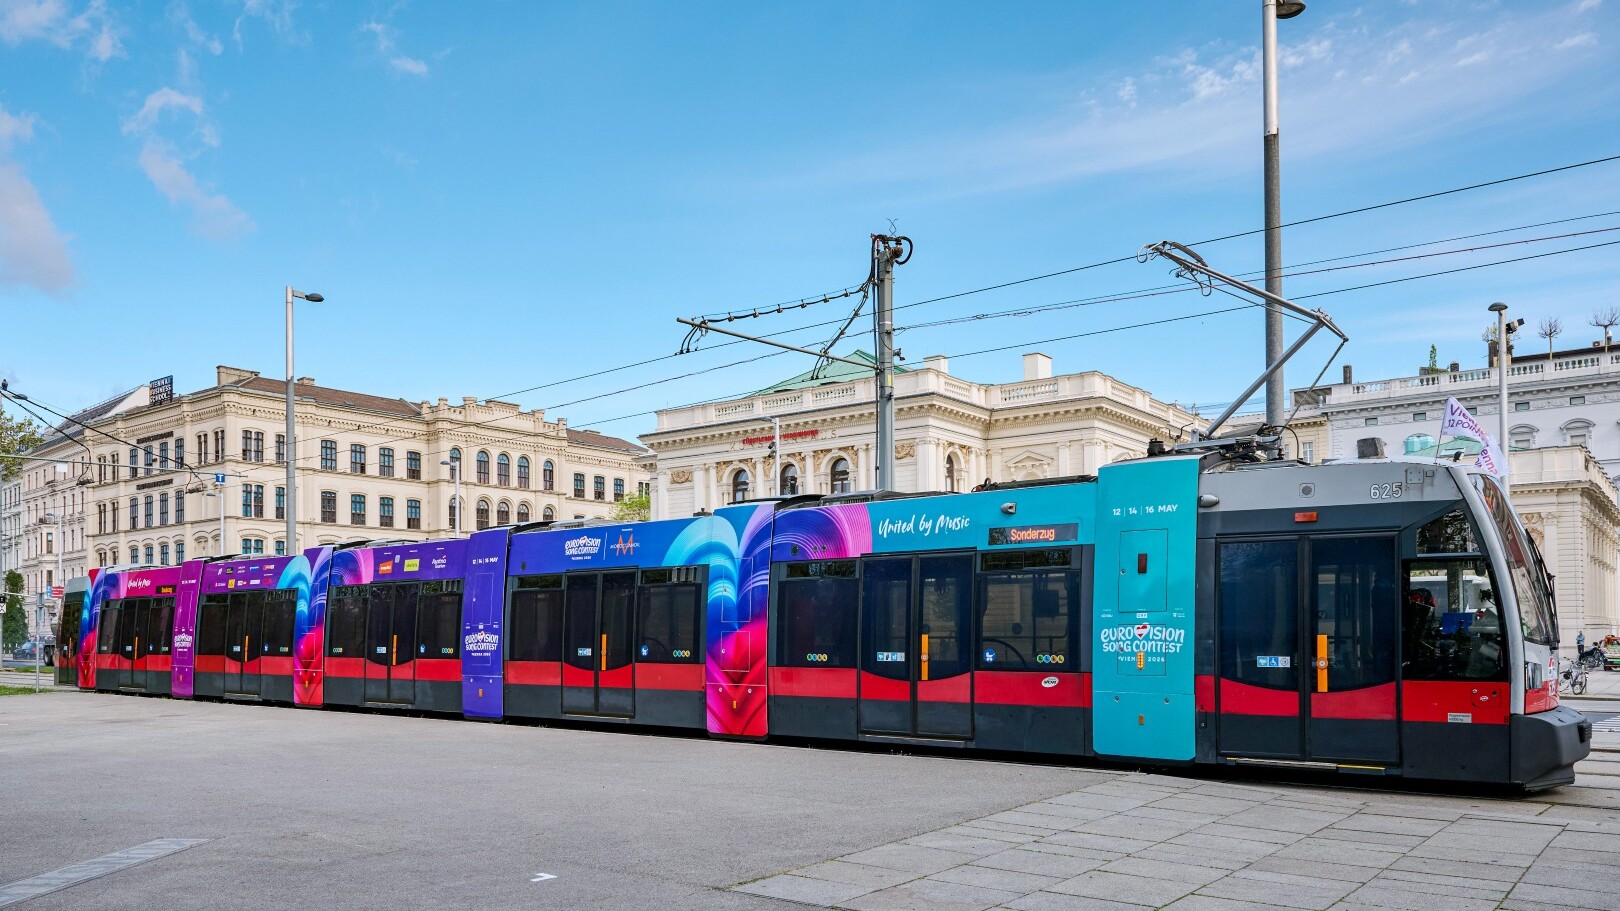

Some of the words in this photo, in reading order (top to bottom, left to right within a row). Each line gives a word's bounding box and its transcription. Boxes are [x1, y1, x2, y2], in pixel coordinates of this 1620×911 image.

[1370, 482, 1402, 499] 625
[1112, 508, 1121, 516] 12
[1128, 506, 1138, 515] 14
[1145, 505, 1154, 514] 16
[1157, 504, 1178, 513] MAY
[878, 518, 916, 538] United
[919, 513, 933, 536] by
[935, 514, 970, 534] Music
[1010, 528, 1055, 541] Sonderzug
